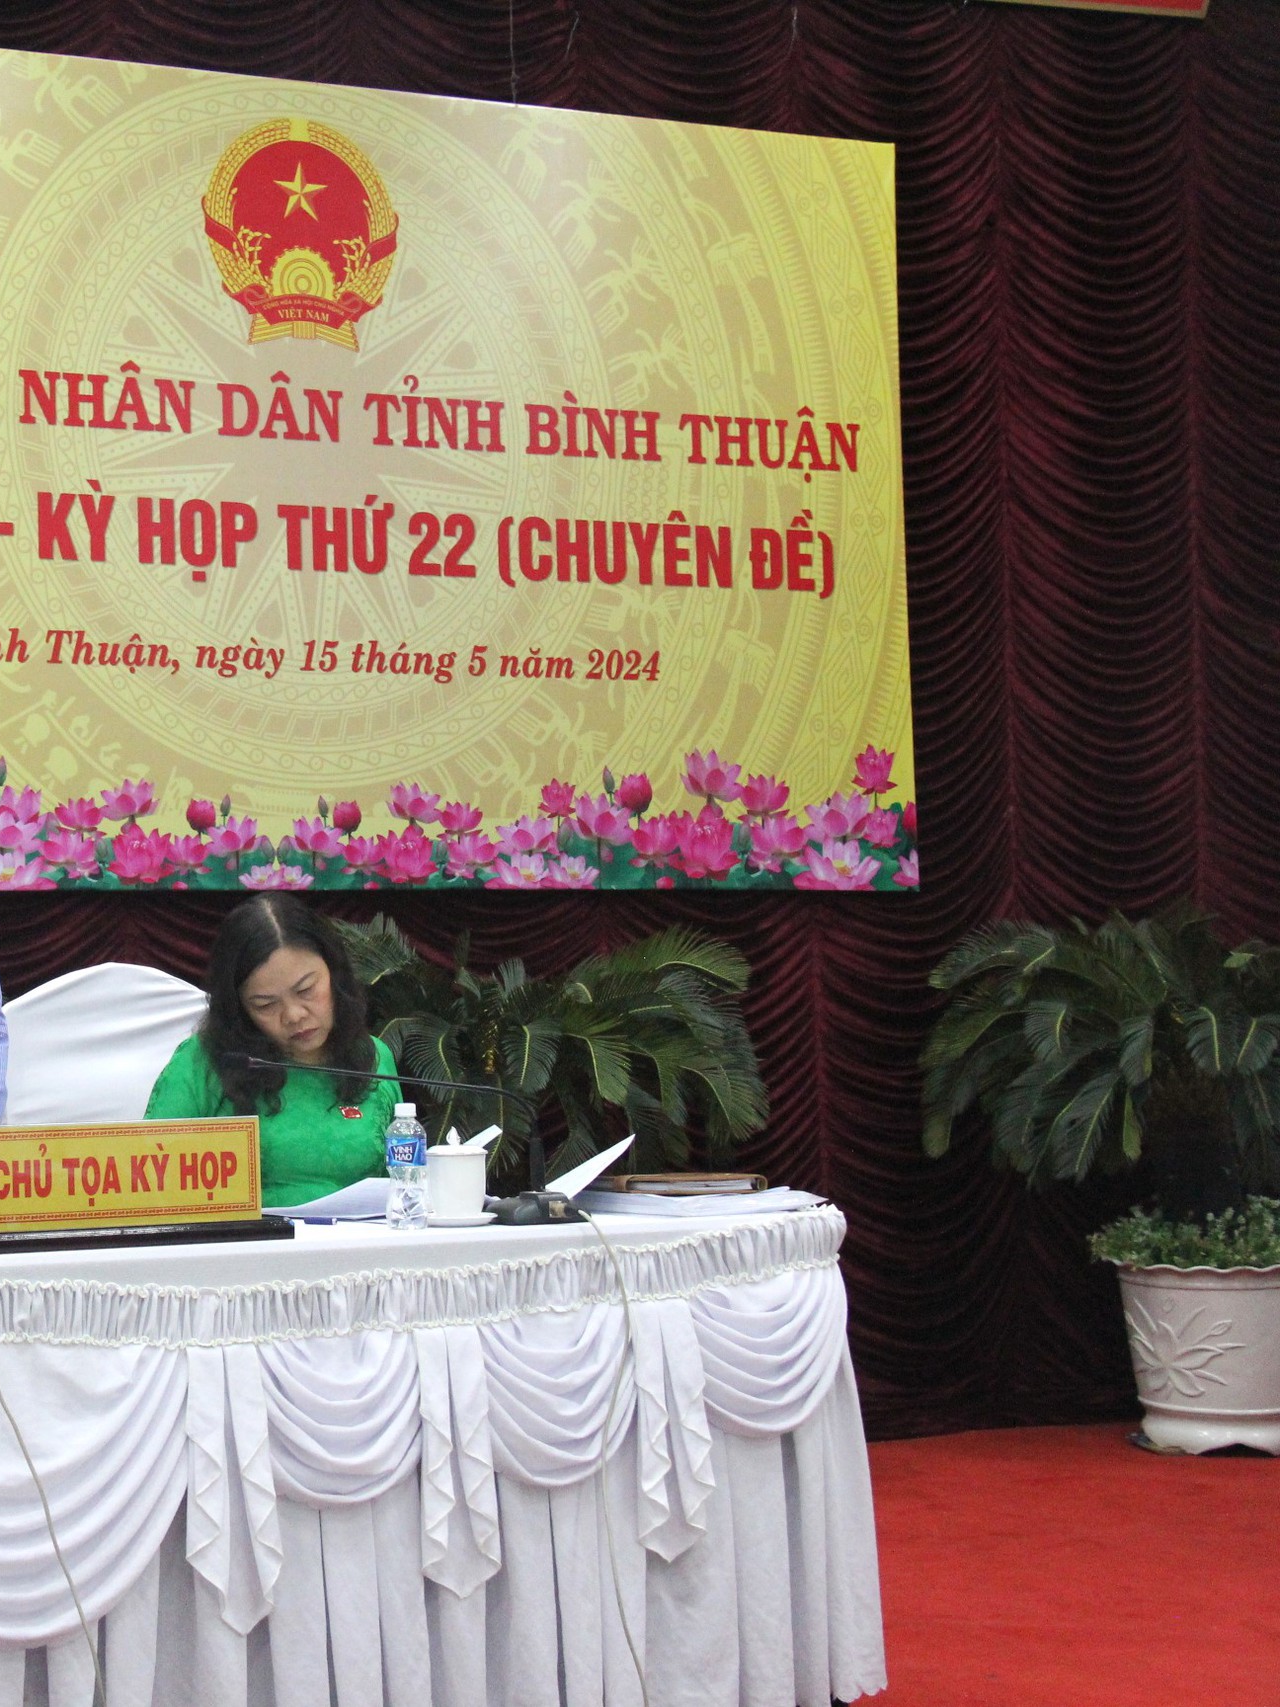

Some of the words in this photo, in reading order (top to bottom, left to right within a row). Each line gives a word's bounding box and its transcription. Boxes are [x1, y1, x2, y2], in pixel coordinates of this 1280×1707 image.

[306, 309, 330, 322] NAM
[19, 362, 195, 433] NHÂN
[217, 371, 342, 443] DÂN
[363, 375, 505, 453] TỈNH
[525, 390, 661, 462] BÌNH
[679, 406, 860, 482] THUẬN
[37, 479, 115, 562] KỲ
[137, 498, 258, 582] HỌP
[278, 494, 395, 575] THỨ
[408, 512, 477, 577] 22
[498, 511, 733, 588] (CHUYÊN
[750, 508, 835, 599] ĐỀ)
[45, 630, 181, 675] Thuận,
[195, 644, 285, 679] ngày
[301, 640, 338, 672] 15
[351, 641, 457, 683] tháng
[468, 645, 487, 674] 5
[499, 646, 575, 679] năm
[586, 649, 661, 682] 2024
[62, 1156, 121, 1207] TỌA
[131, 1143, 170, 1193] KỲ
[179, 1151, 238, 1201] HỌP
